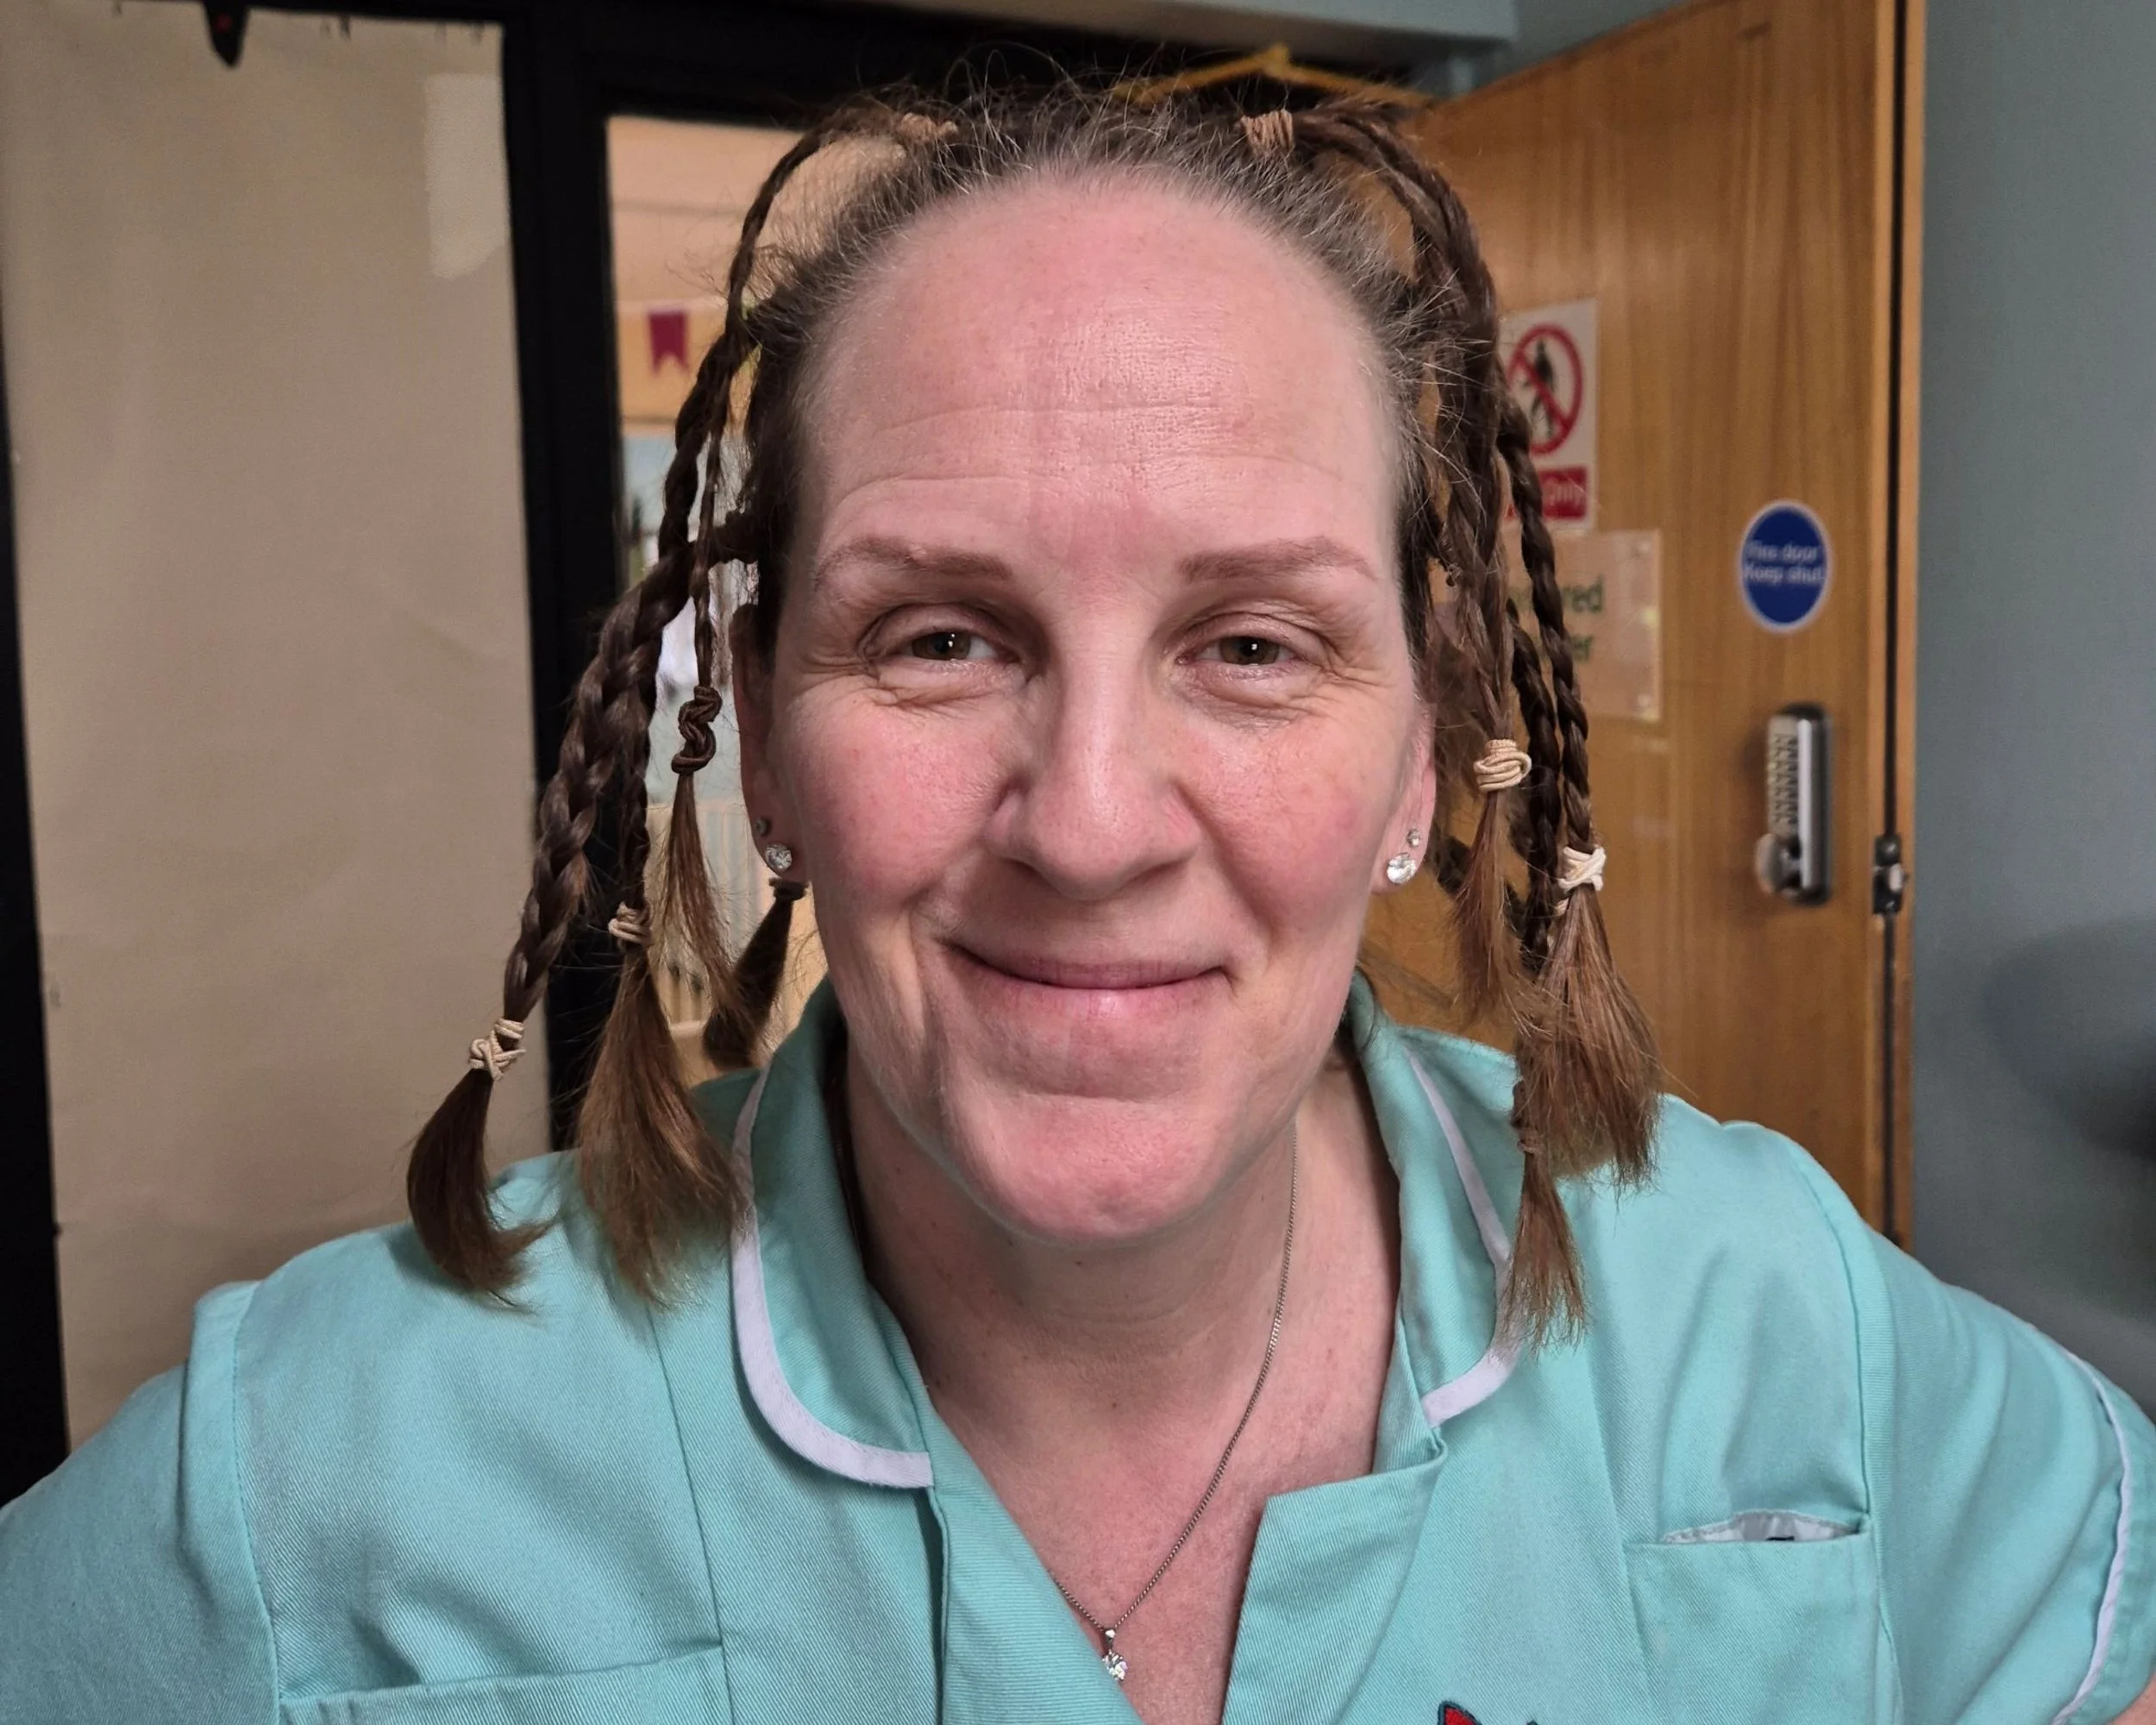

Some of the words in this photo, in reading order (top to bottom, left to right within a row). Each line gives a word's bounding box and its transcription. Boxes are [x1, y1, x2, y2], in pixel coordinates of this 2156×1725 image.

[1782, 541, 1819, 561] door
[1744, 561, 1783, 586] Keep
[1787, 565, 1823, 584] shut
